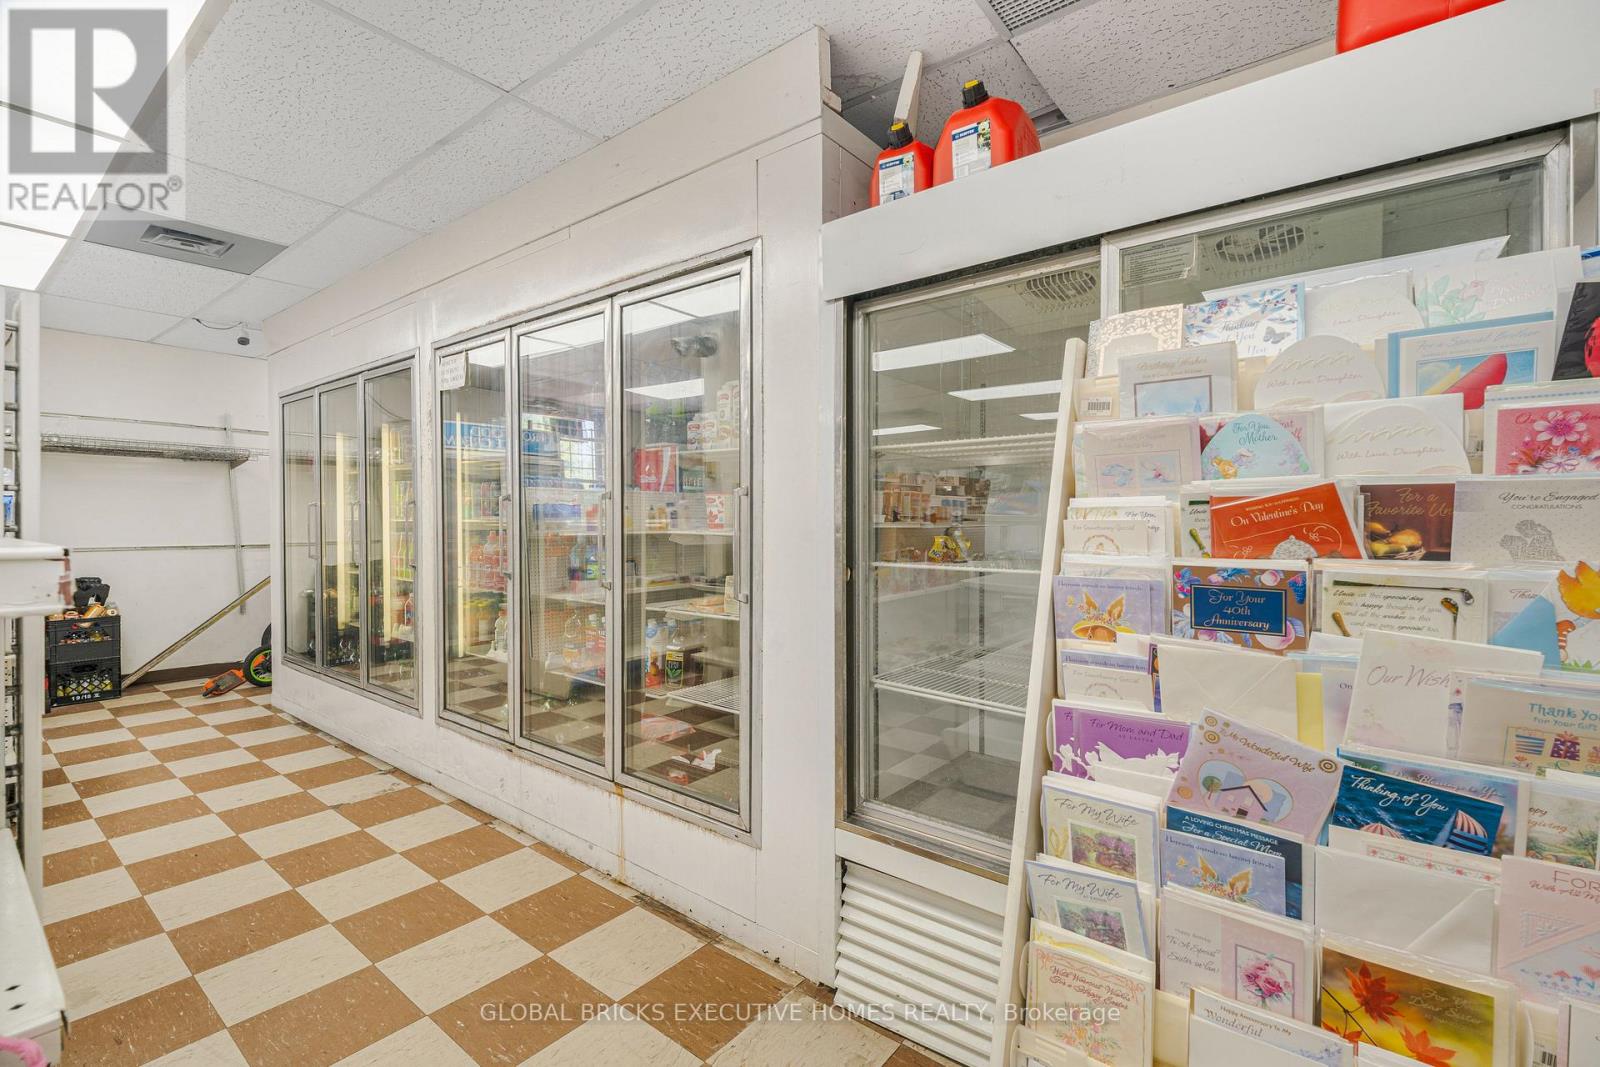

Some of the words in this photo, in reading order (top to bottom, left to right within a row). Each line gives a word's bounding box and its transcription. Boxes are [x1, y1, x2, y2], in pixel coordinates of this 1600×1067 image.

[1239, 431, 1278, 446] Mother
[1396, 487, 1424, 503] For
[1498, 490, 1539, 502] You're
[1542, 491, 1600, 502] Engaged
[1230, 515, 1249, 527] On
[1250, 506, 1298, 523] Valentine's
[1300, 501, 1324, 513] Day
[1366, 501, 1425, 517] Favorite
[1208, 589, 1233, 604] For
[1235, 591, 1266, 606] Your
[1223, 606, 1251, 616] 40th
[1203, 613, 1269, 631] Anniversary
[1367, 665, 1403, 686] Our
[1529, 703, 1577, 724] Thank
[1553, 719, 1576, 728] Your
[1090, 718, 1106, 729] For
[1107, 721, 1135, 734] Mom
[1138, 729, 1157, 738] and
[1158, 729, 1185, 742] Dad
[1240, 737, 1291, 763] Wonderful
[1289, 756, 1317, 774] Wife
[1350, 774, 1400, 807] Thinking
[1400, 793, 1419, 807] of
[1414, 794, 1449, 817] You
[1054, 798, 1077, 810] For
[1078, 802, 1104, 821] My
[1104, 808, 1139, 827] Wife
[1181, 820, 1204, 836] For
[1210, 830, 1249, 848] Special
[1190, 816, 1215, 828] LOVING
[1214, 822, 1250, 836] CHRISTMAS
[1249, 832, 1278, 846] MESSAGE
[1037, 873, 1060, 886] For
[1060, 877, 1086, 895] My
[1085, 882, 1122, 899] Wife
[1219, 1005, 1238, 1017] Happy
[1203, 1008, 1264, 1038] Wonderful
